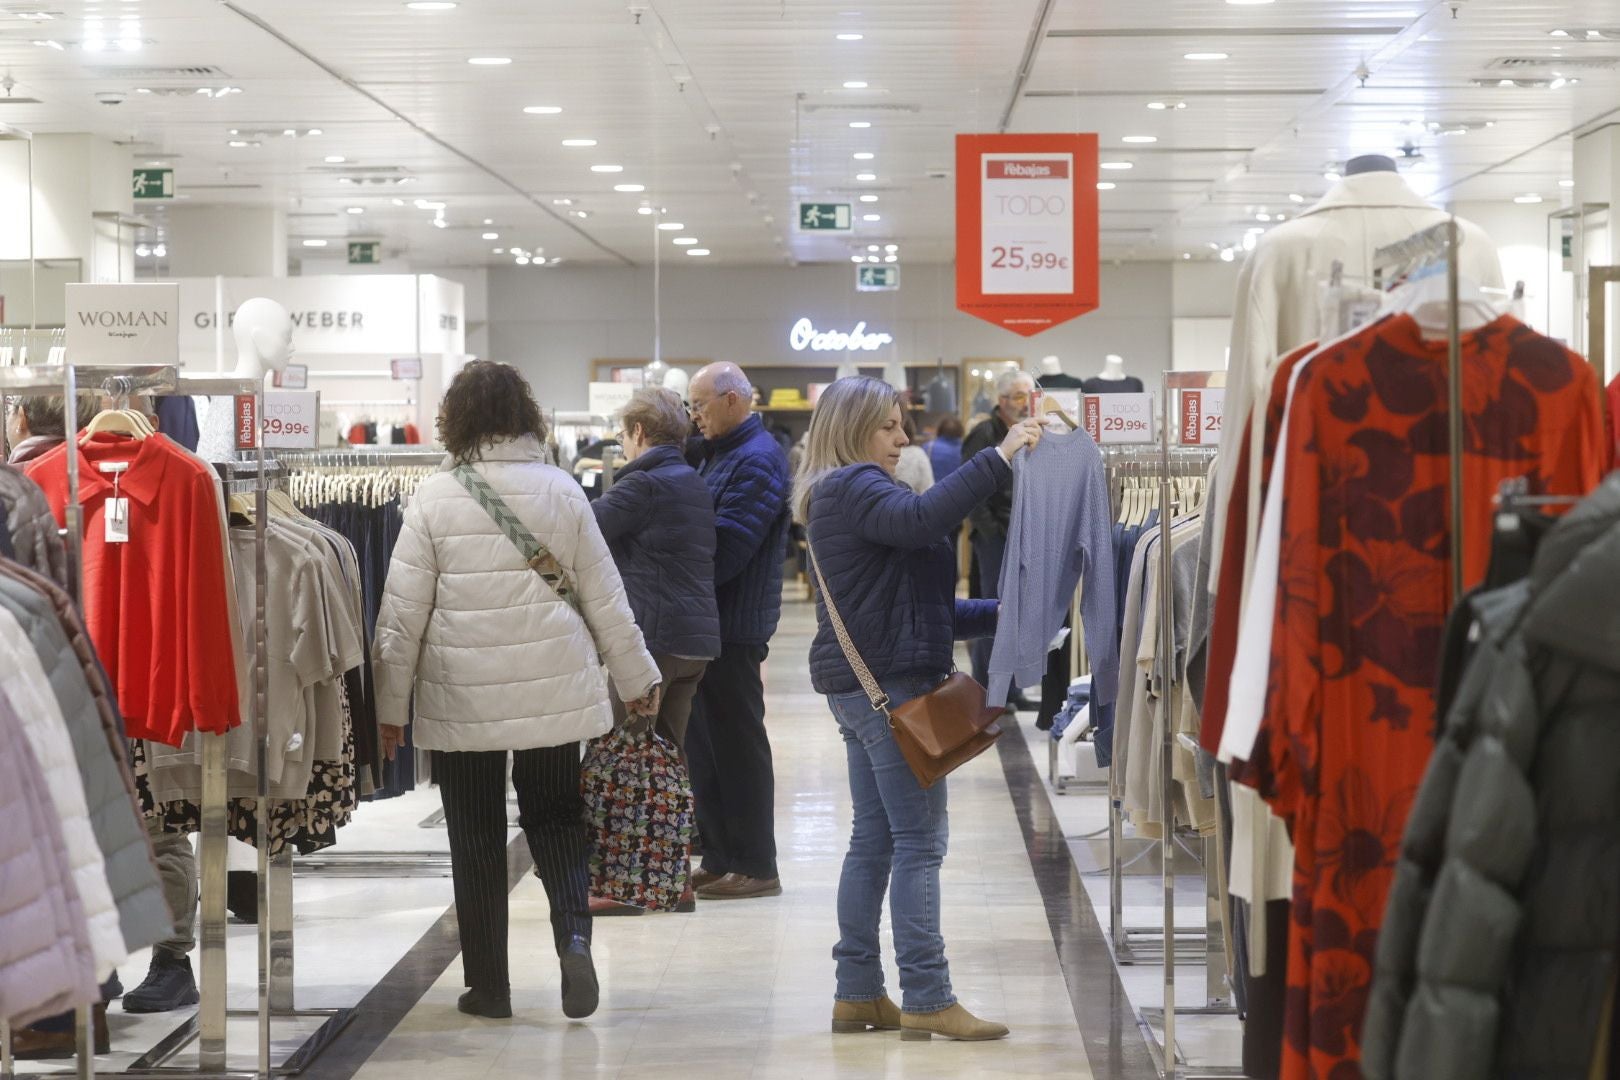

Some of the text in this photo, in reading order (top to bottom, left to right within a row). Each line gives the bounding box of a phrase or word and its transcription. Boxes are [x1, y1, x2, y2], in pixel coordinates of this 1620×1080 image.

[994, 195, 1066, 215] TODO
[991, 246, 1068, 271] 25,99€
[78, 311, 168, 327] WOMAN
[790, 317, 893, 351] October
[267, 404, 302, 414] TODO
[241, 402, 253, 443] rebajas
[263, 418, 309, 435] 29,99€
[1103, 417, 1148, 432] 29,99€
[1186, 400, 1198, 440] rebajas
